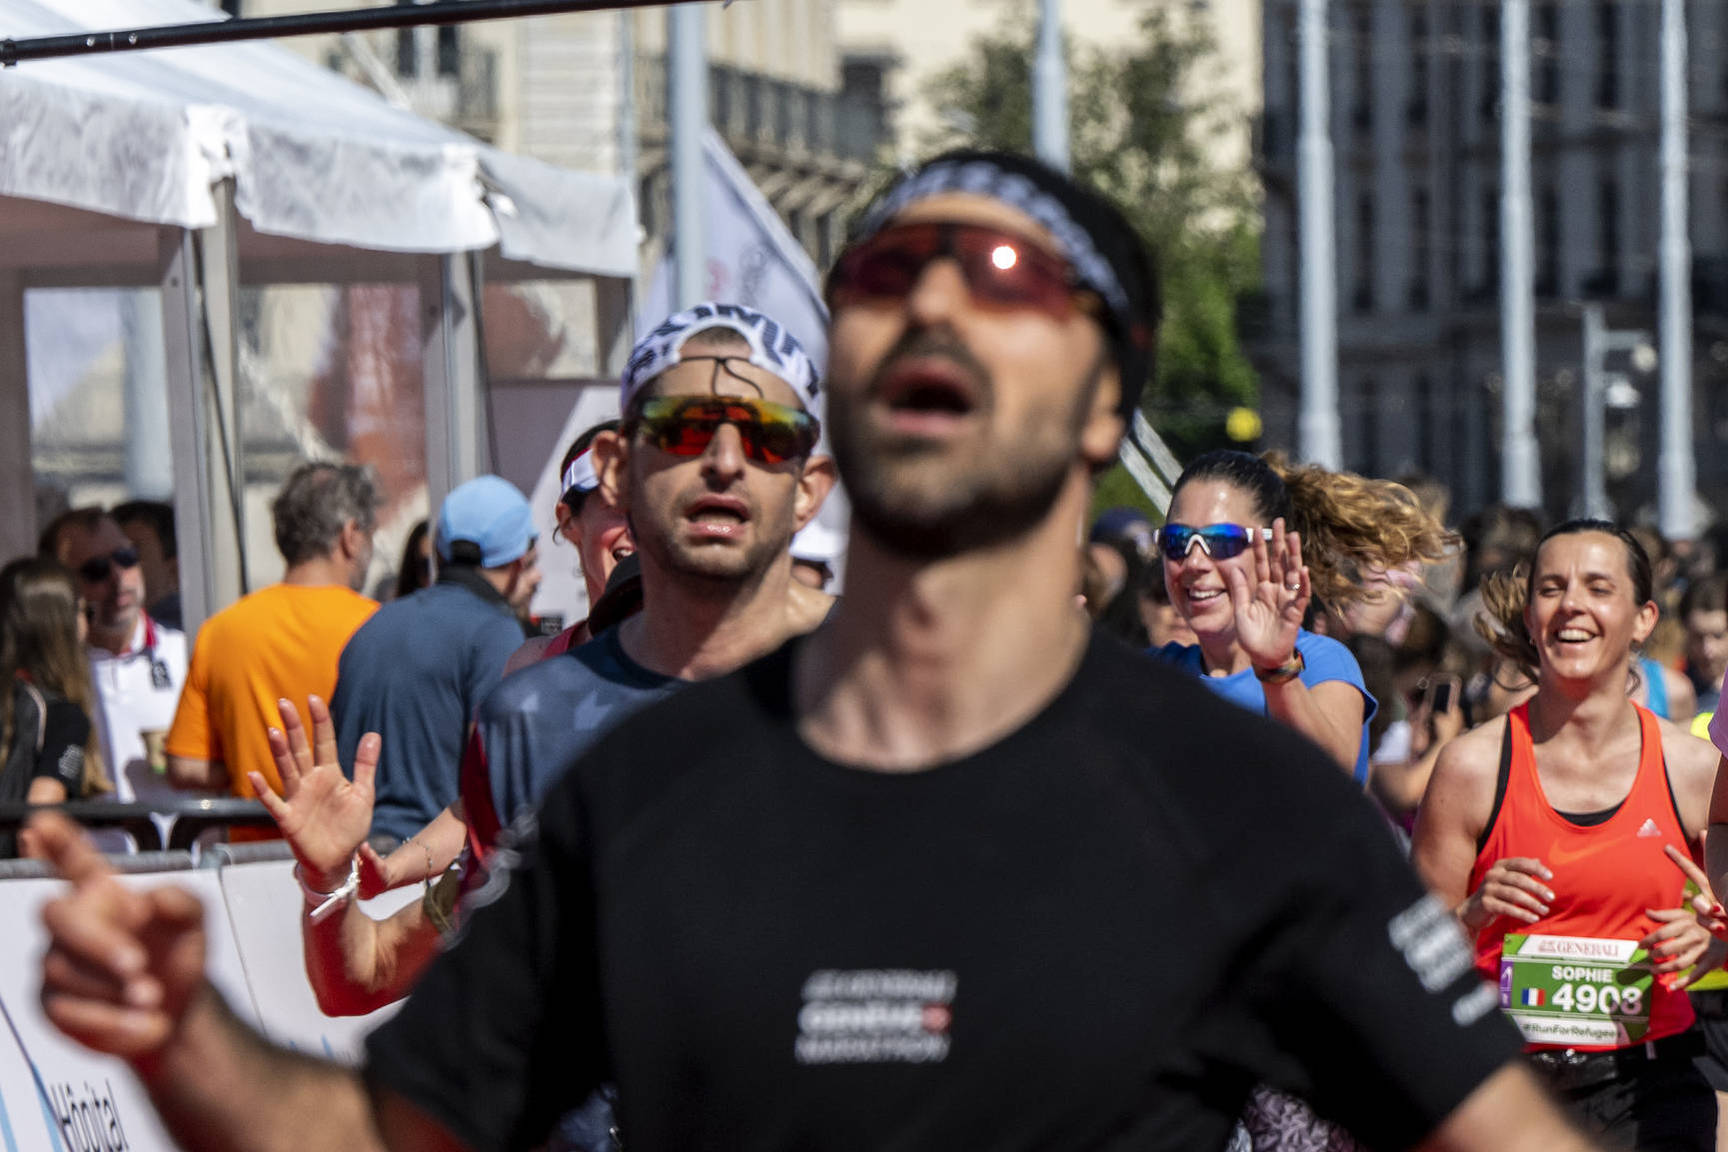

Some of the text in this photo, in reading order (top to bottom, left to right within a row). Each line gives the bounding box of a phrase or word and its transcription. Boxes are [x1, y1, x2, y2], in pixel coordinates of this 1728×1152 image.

[1555, 941, 1620, 958] GENERALI
[1551, 965, 1614, 983] SOPHIE
[1551, 983, 1643, 1016] 4908
